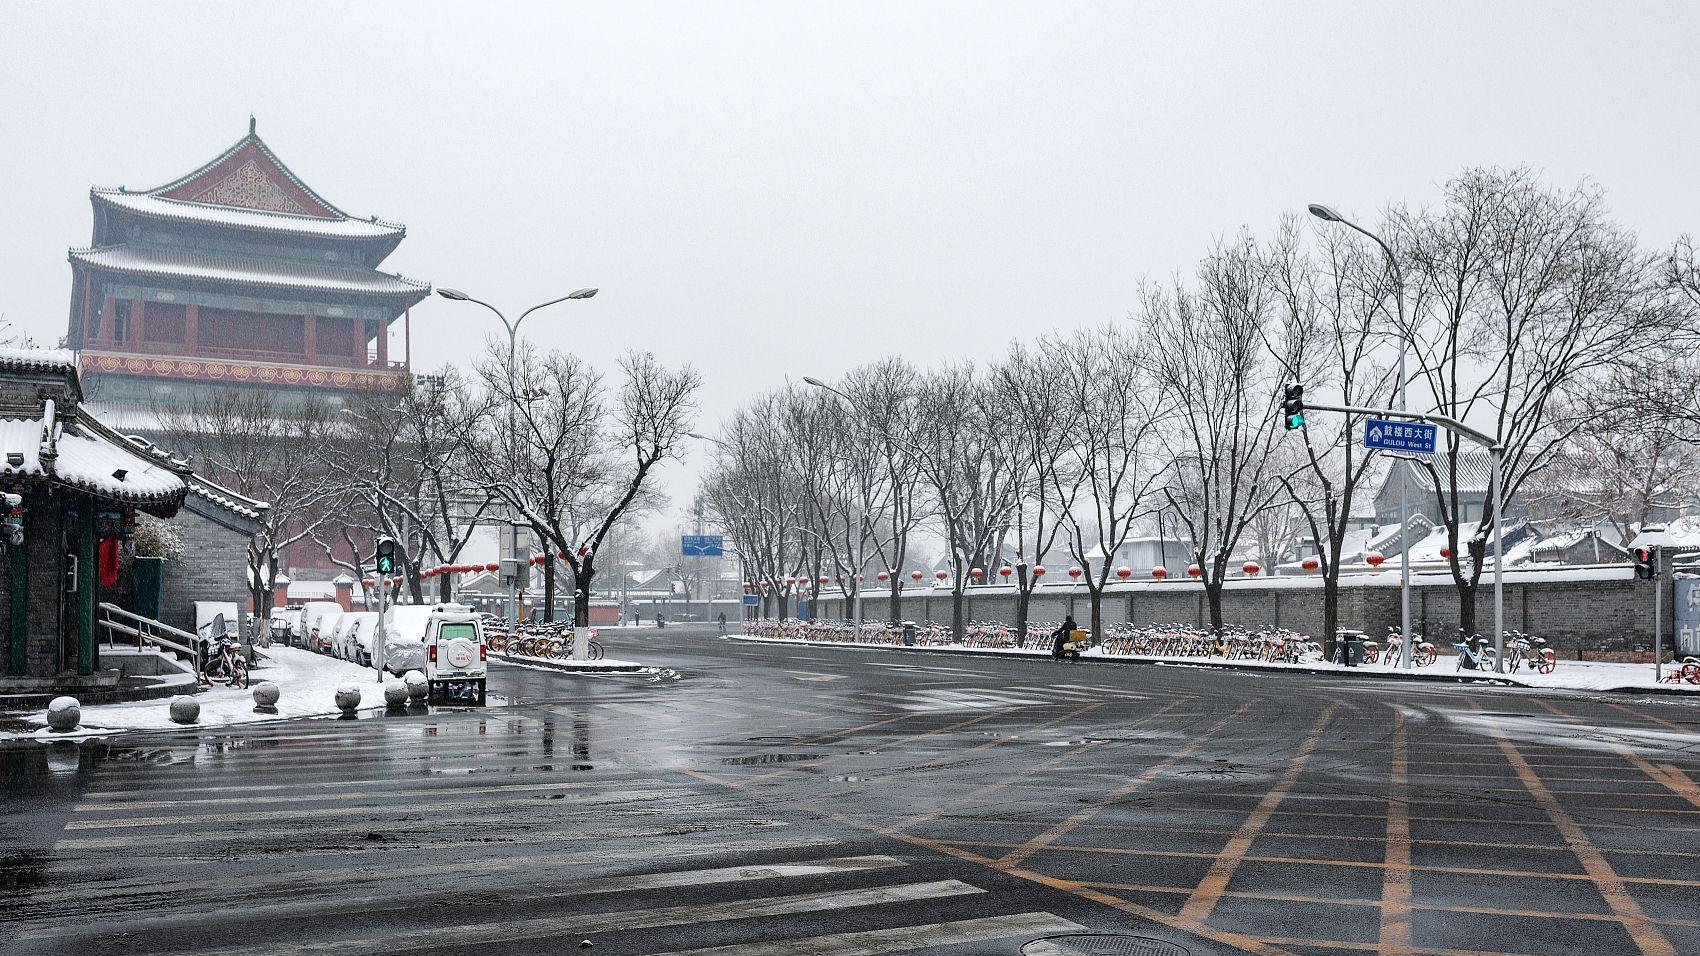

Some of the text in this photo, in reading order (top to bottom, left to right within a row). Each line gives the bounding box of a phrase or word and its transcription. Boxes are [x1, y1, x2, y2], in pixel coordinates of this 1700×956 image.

[1384, 425, 1432, 440] 鼓楼西大街
